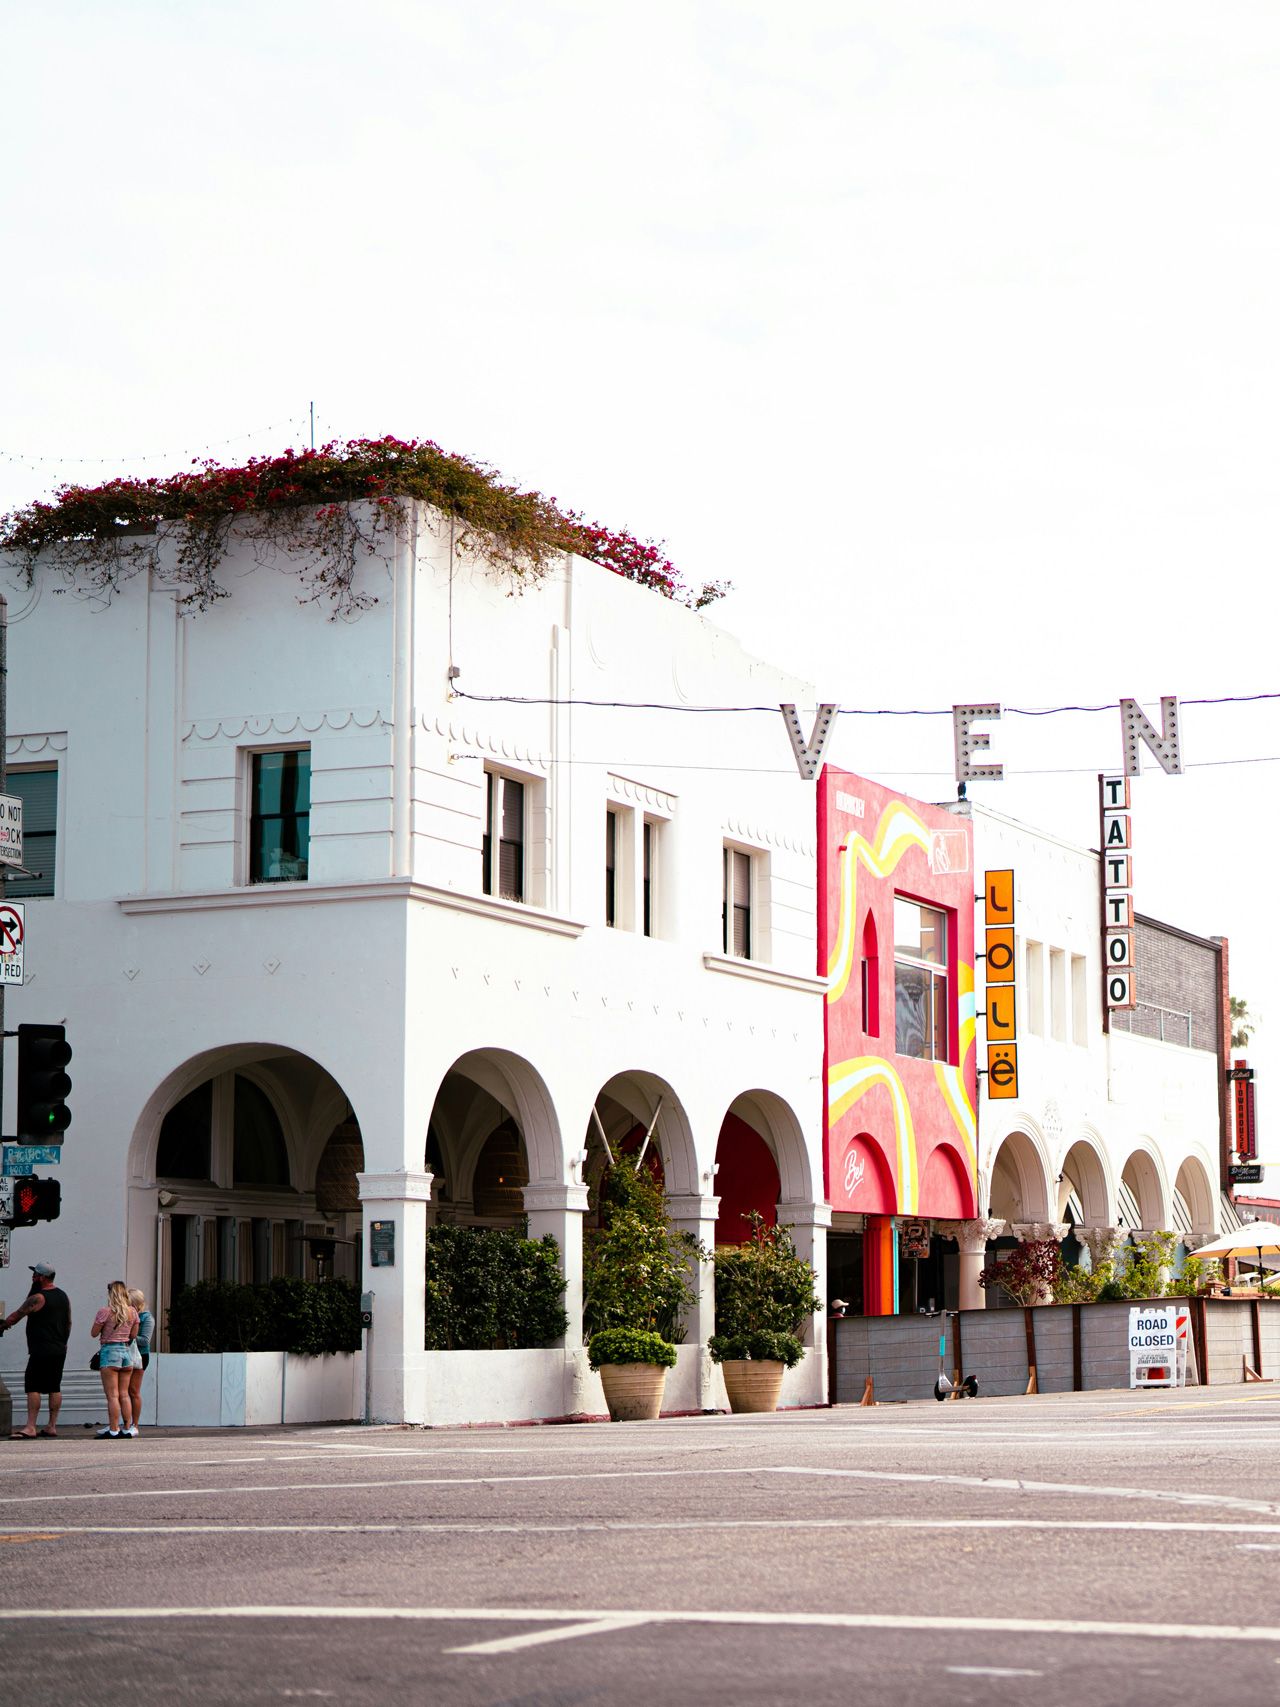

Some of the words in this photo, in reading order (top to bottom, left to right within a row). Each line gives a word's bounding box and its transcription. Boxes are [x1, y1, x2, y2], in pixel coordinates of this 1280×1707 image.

[8, 805, 21, 822] NOT
[1105, 780, 1126, 1002] TATTOO
[5, 963, 21, 978] RED
[1137, 1318, 1168, 1331] ROAD
[1131, 1335, 1174, 1347] CLOSED
